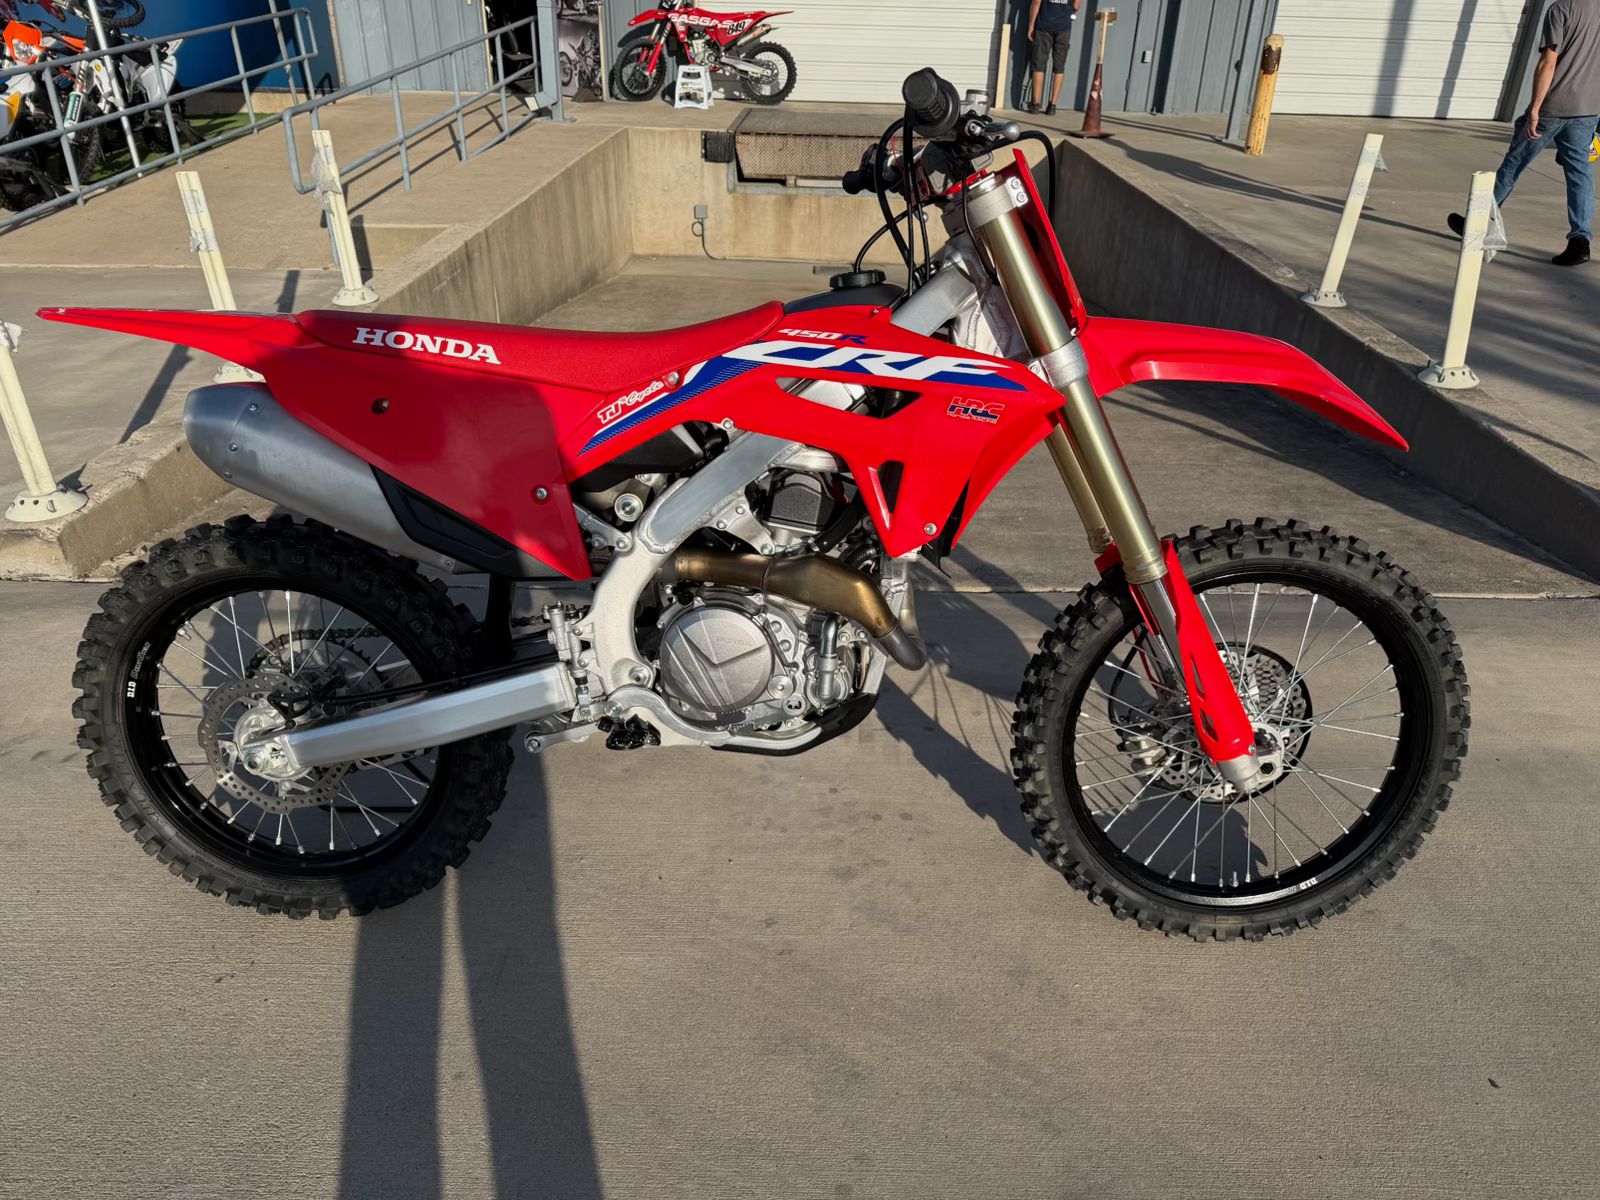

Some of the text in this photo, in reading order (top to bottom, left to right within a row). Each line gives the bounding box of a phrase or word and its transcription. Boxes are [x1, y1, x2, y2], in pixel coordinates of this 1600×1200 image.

[667, 13, 734, 28] GASGAS
[727, 20, 745, 35] 849
[352, 327, 501, 365] HONDA
[777, 328, 868, 345] 450R
[722, 339, 1013, 381] CRF
[625, 380, 665, 406] Cycle
[947, 396, 1005, 420] HRC
